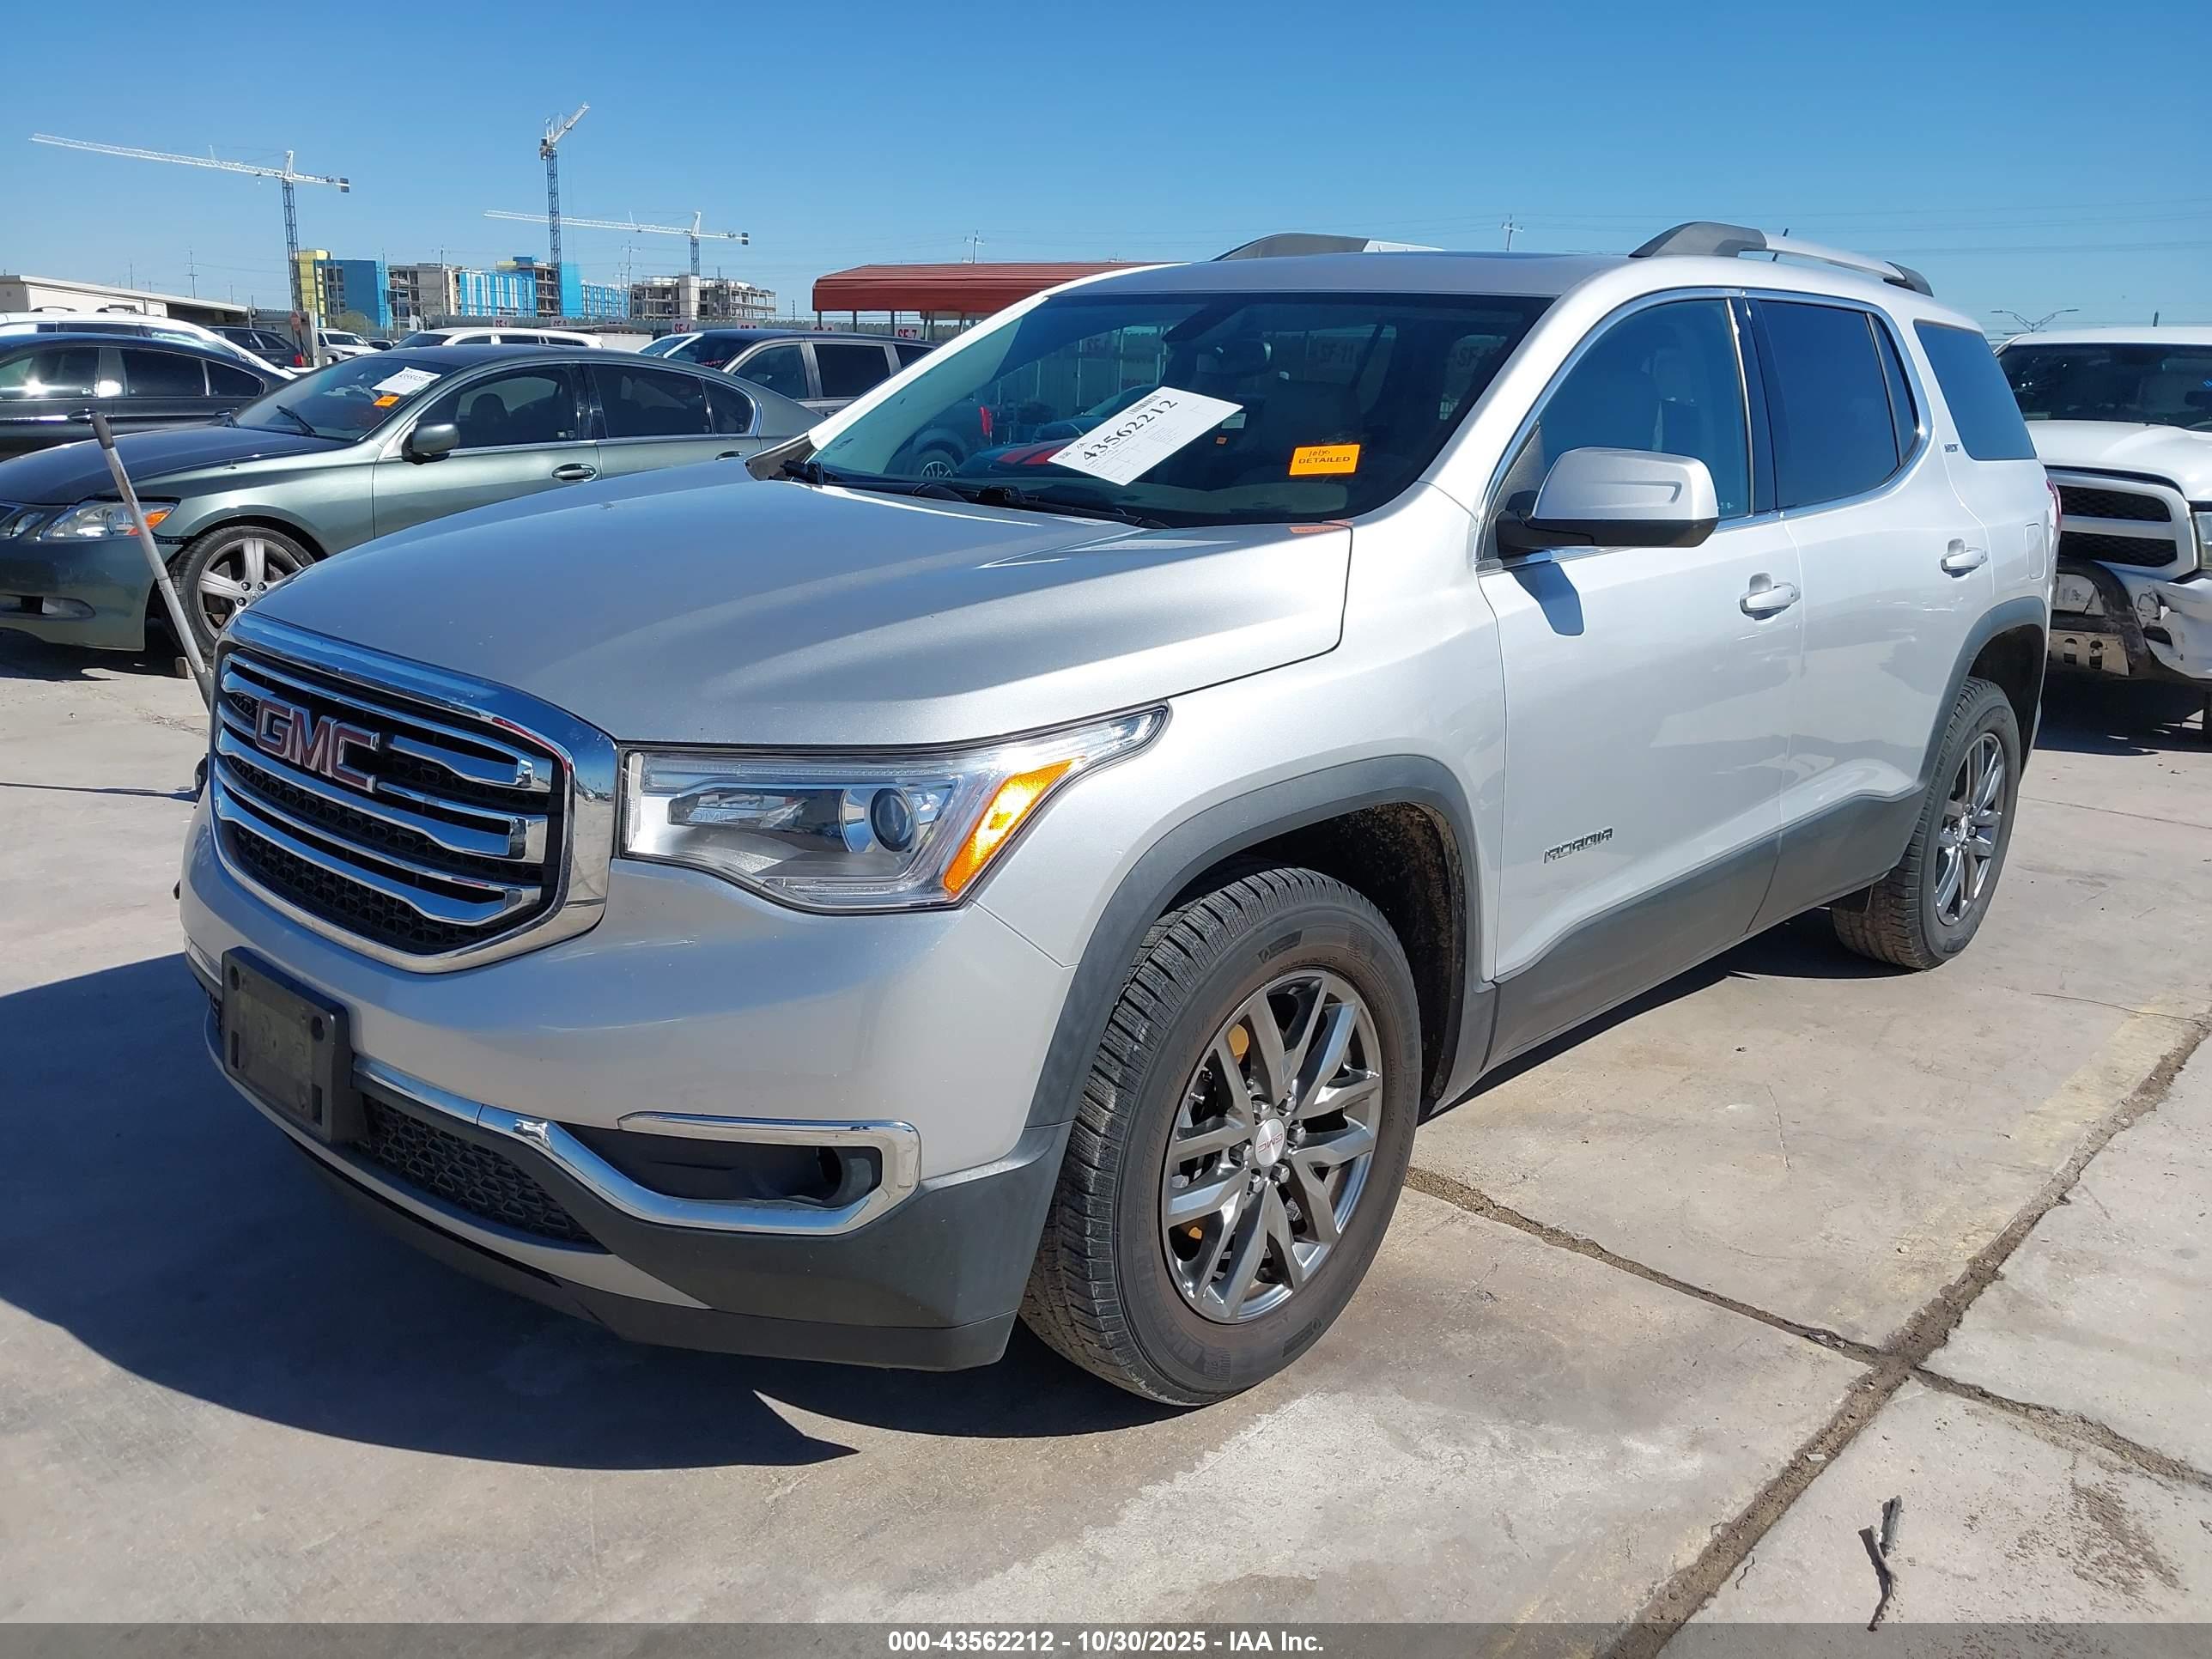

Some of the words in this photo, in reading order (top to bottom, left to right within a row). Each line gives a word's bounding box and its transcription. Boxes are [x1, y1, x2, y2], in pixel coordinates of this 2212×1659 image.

[1082, 398, 1179, 461] 43562212
[254, 697, 380, 794] GMC
[1543, 827, 1613, 864] ACADIA
[1258, 1133, 1284, 1153] GMC
